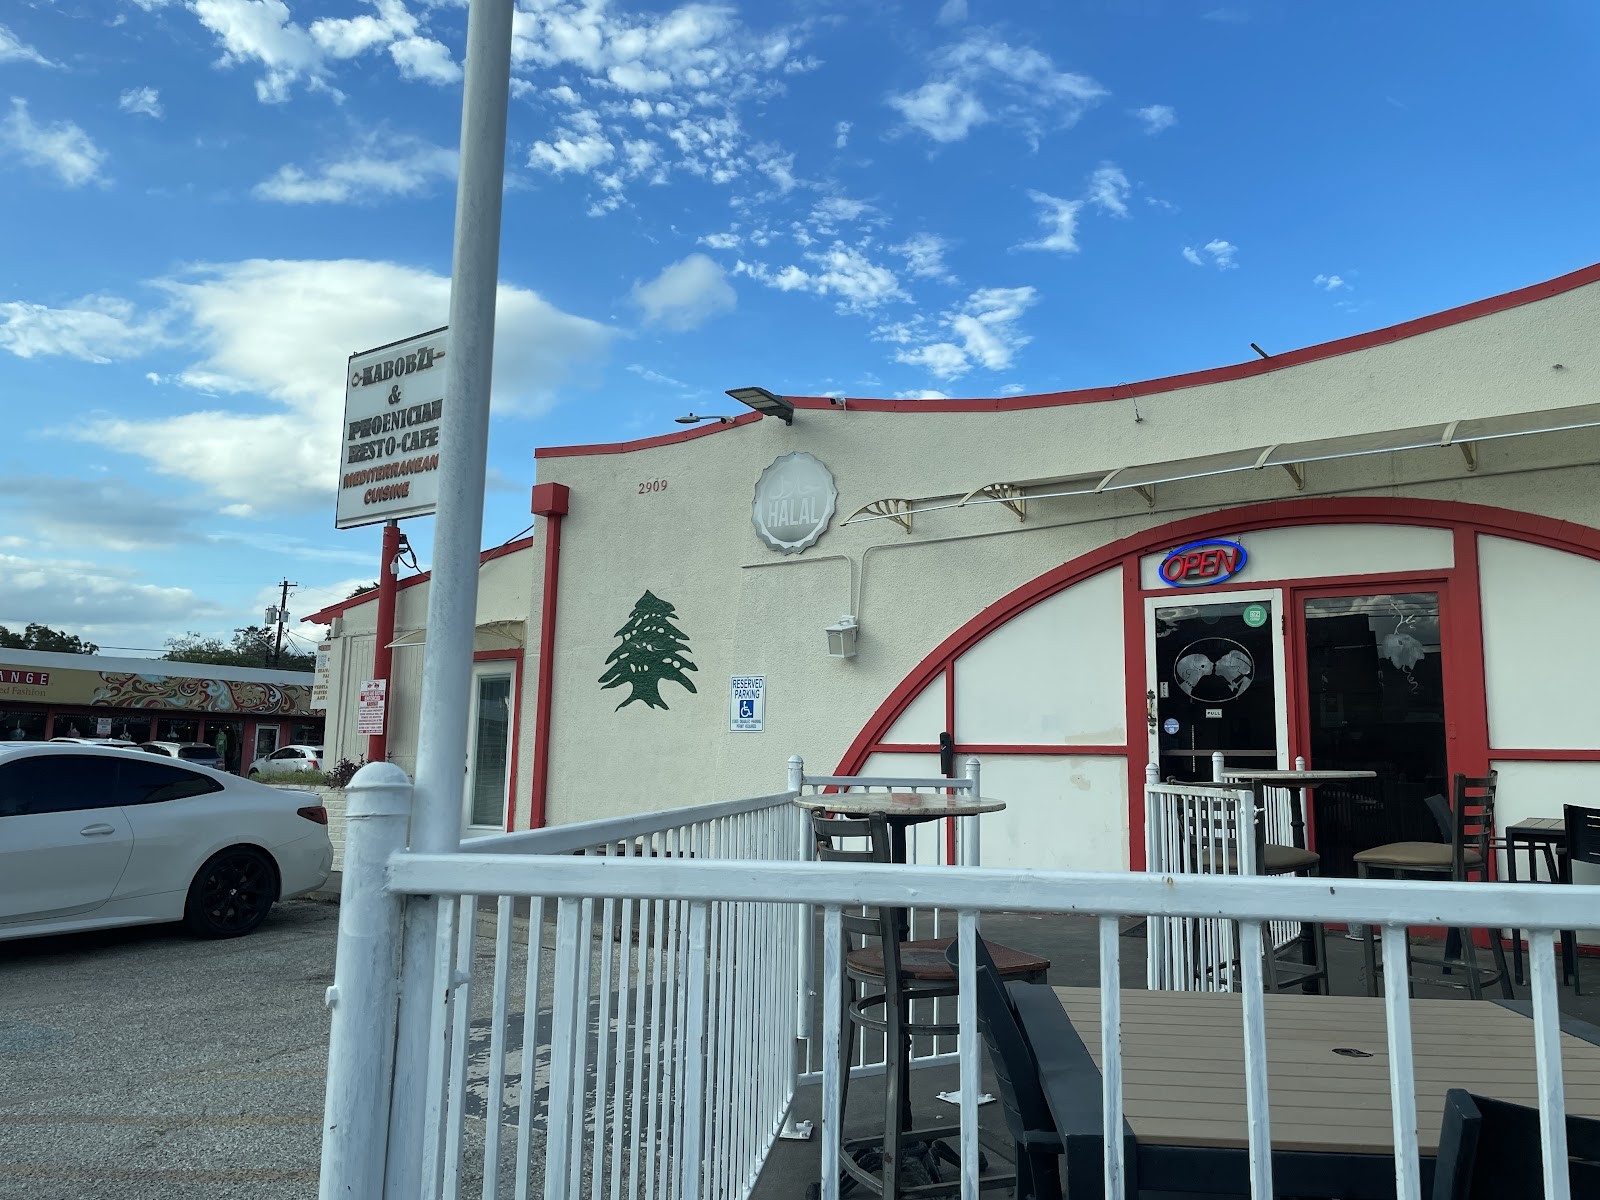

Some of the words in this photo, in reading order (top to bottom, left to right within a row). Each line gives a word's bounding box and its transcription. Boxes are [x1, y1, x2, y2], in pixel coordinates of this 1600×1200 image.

[388, 384, 402, 405] &
[347, 398, 443, 441] PHOENICIAN
[347, 426, 439, 464] RESTO-CAFE
[343, 453, 439, 490] MEDITERRANEAN
[364, 481, 410, 505] CUISINE
[638, 479, 668, 494] 2909
[768, 496, 820, 528] HALAL
[1163, 547, 1238, 582] OPEN
[11, 686, 46, 697] Fashion
[732, 678, 763, 689] RESERVED
[734, 689, 760, 699] PARKING
